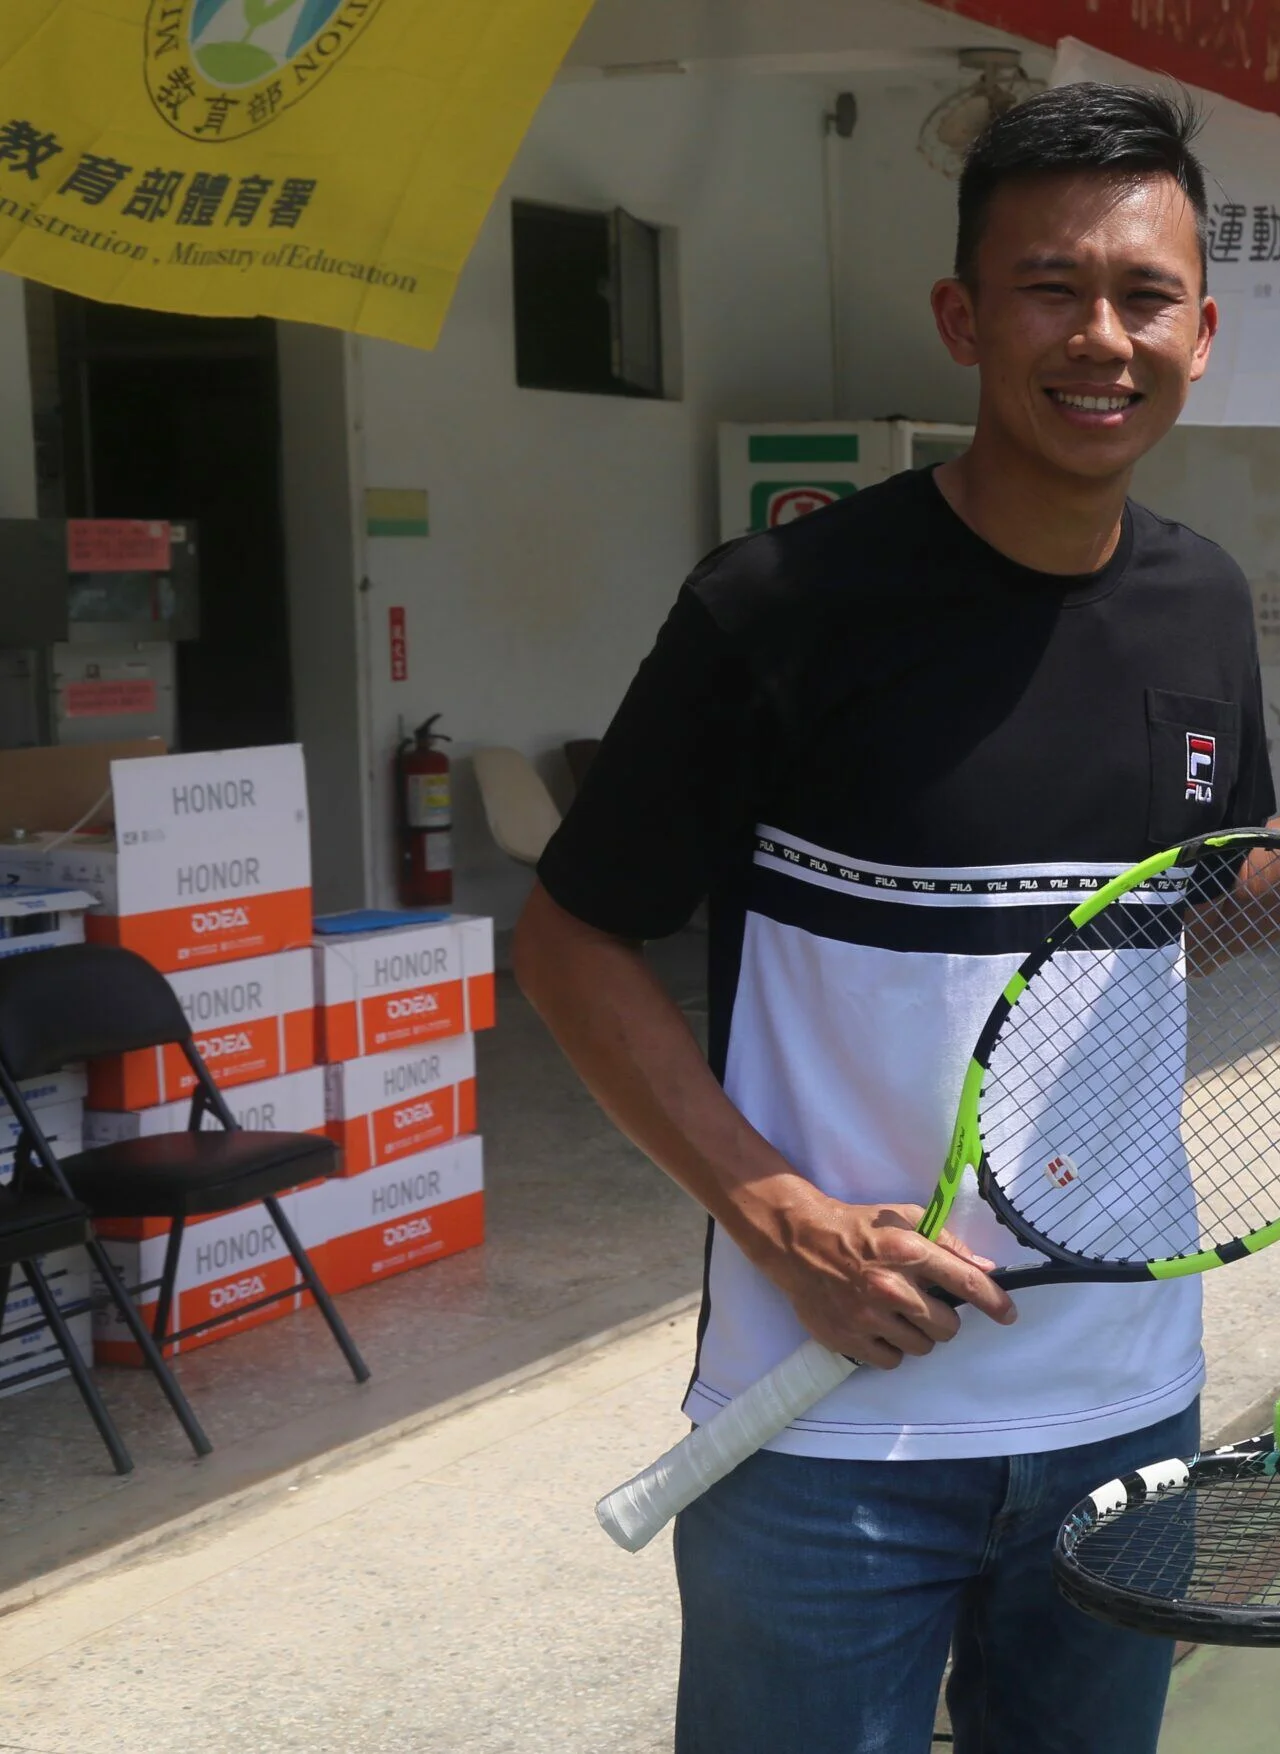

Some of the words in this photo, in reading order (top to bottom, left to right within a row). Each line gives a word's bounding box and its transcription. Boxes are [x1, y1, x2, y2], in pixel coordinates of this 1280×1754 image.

[157, 66, 283, 135] 教育部
[0, 119, 318, 229] 教育部體育署
[168, 241, 257, 273] Ministry
[287, 244, 418, 294] Education
[172, 779, 256, 816] HONOR
[1185, 781, 1212, 803] FILA
[177, 858, 260, 896] HONOR
[759, 840, 775, 852] FILA
[783, 848, 800, 863] FILA
[809, 859, 828, 872] FILA
[839, 868, 860, 882] FILA
[874, 876, 898, 888] FILA
[912, 880, 936, 891] FILA
[950, 882, 973, 892] FILA
[986, 881, 1008, 891] FILA
[1019, 879, 1039, 890] FILA
[1050, 879, 1068, 889] FILA
[1079, 878, 1098, 888] FILA
[191, 906, 249, 933] ODEA
[374, 947, 448, 985] HONOR
[180, 981, 263, 1022] HONOR
[386, 994, 438, 1020] ODEA
[383, 1054, 441, 1097] HONOR
[393, 1101, 434, 1130] ODEA
[371, 1170, 441, 1215] HONOR
[196, 1224, 277, 1275] HONOR
[383, 1217, 432, 1247] ODEA
[209, 1275, 265, 1309] ODEA
